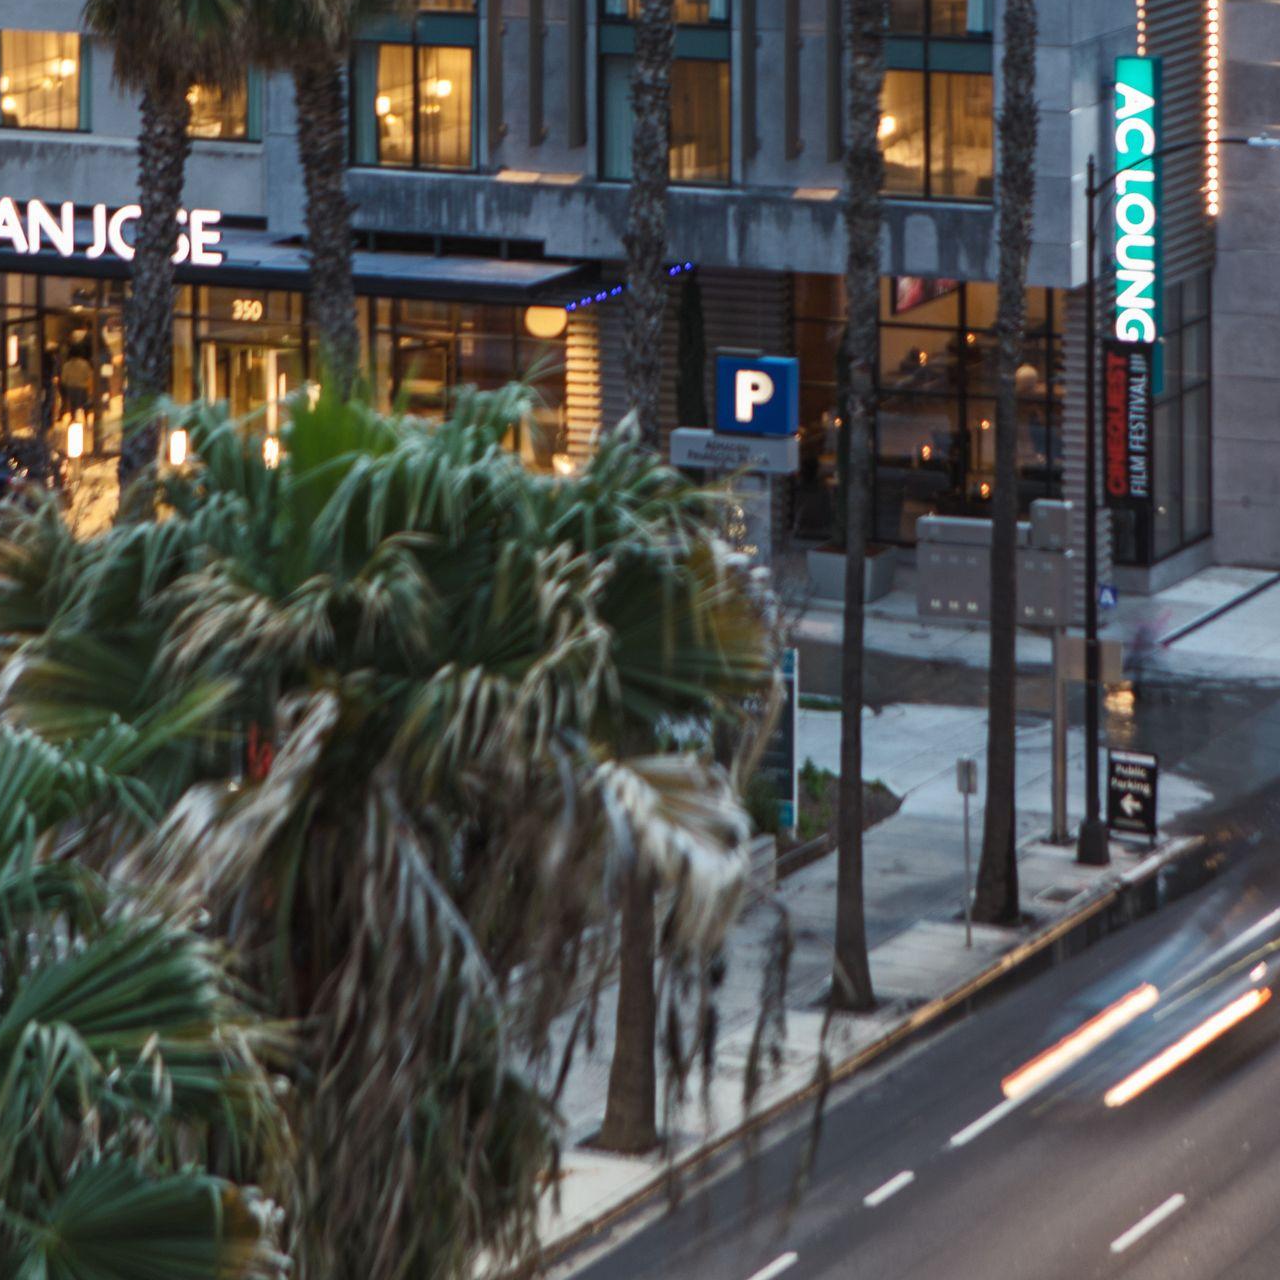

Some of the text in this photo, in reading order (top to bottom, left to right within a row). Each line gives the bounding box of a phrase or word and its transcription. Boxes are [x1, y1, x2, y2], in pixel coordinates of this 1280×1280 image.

[1115, 82, 1155, 343] AC LOUNG
[232, 299, 263, 321] 350
[735, 369, 775, 422] P
[1128, 375, 1148, 452] FESTIVAL
[1128, 456, 1148, 497] FILM
